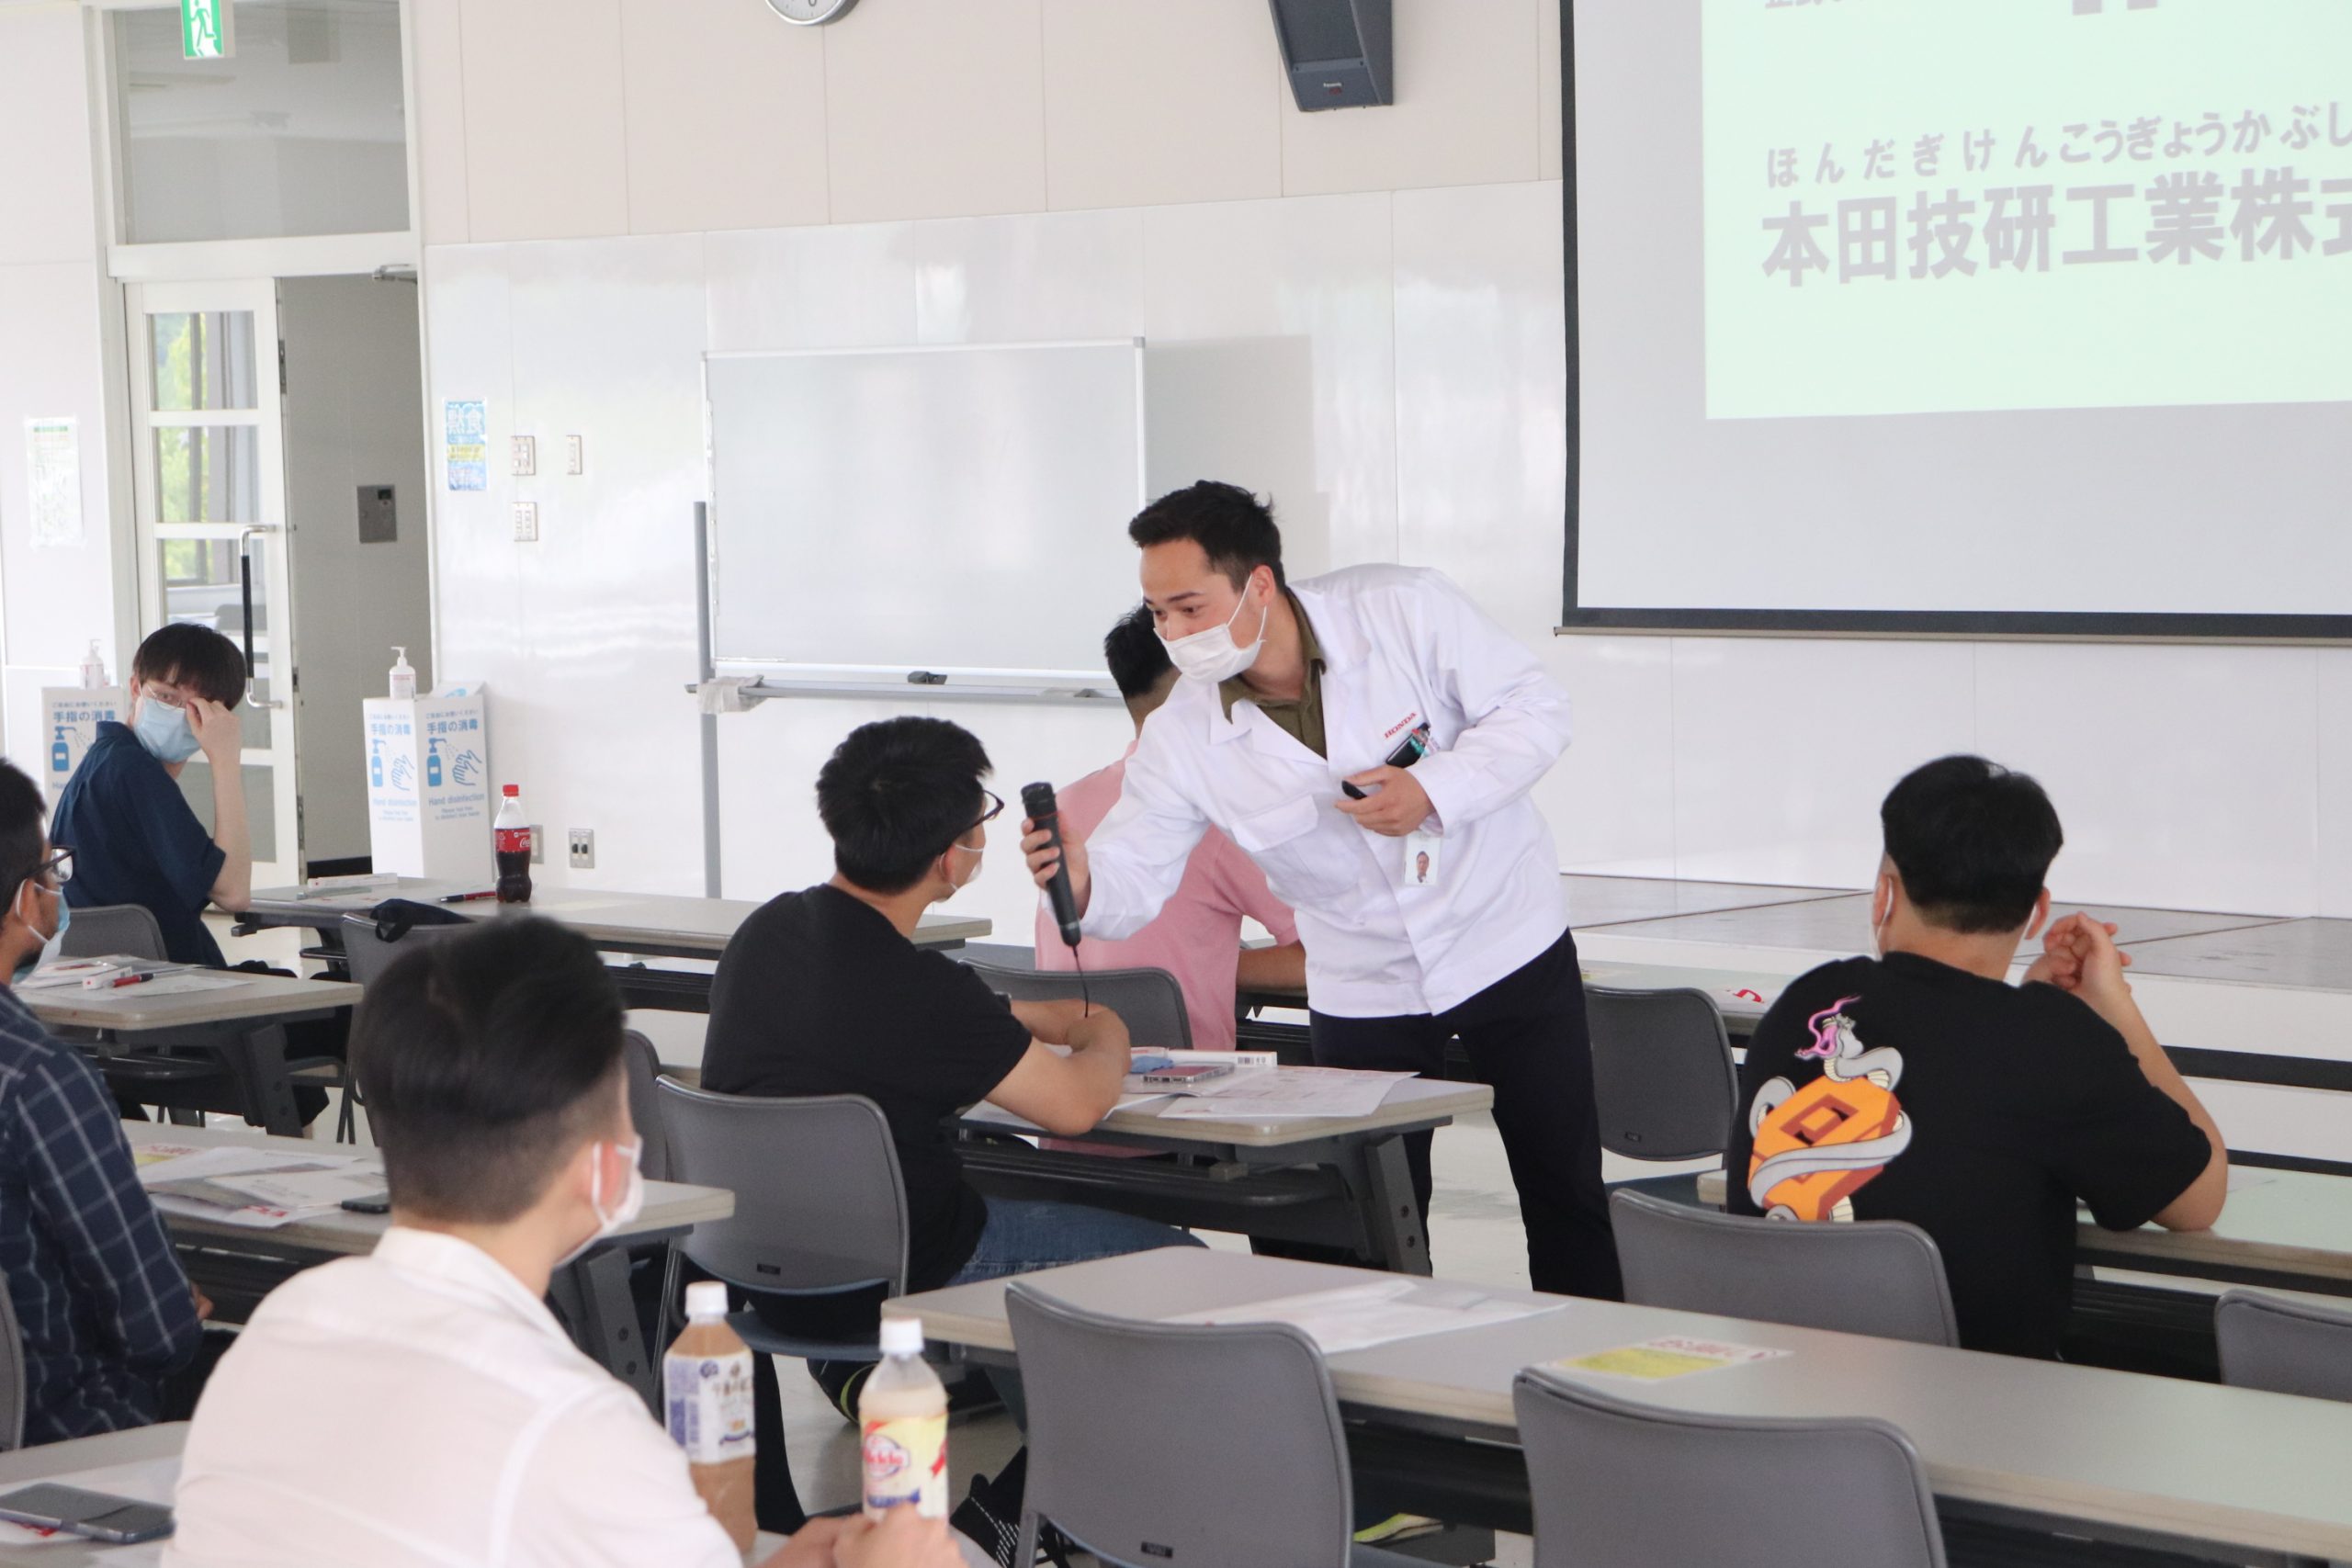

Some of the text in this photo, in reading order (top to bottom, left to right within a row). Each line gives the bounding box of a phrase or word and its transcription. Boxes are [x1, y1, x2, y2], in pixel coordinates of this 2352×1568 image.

[53, 710, 115, 723] 手指の消毒
[370, 723, 411, 736] 手指の消毒
[426, 718, 479, 735] 手指の消毒
[1385, 712, 1417, 739] HONDA
